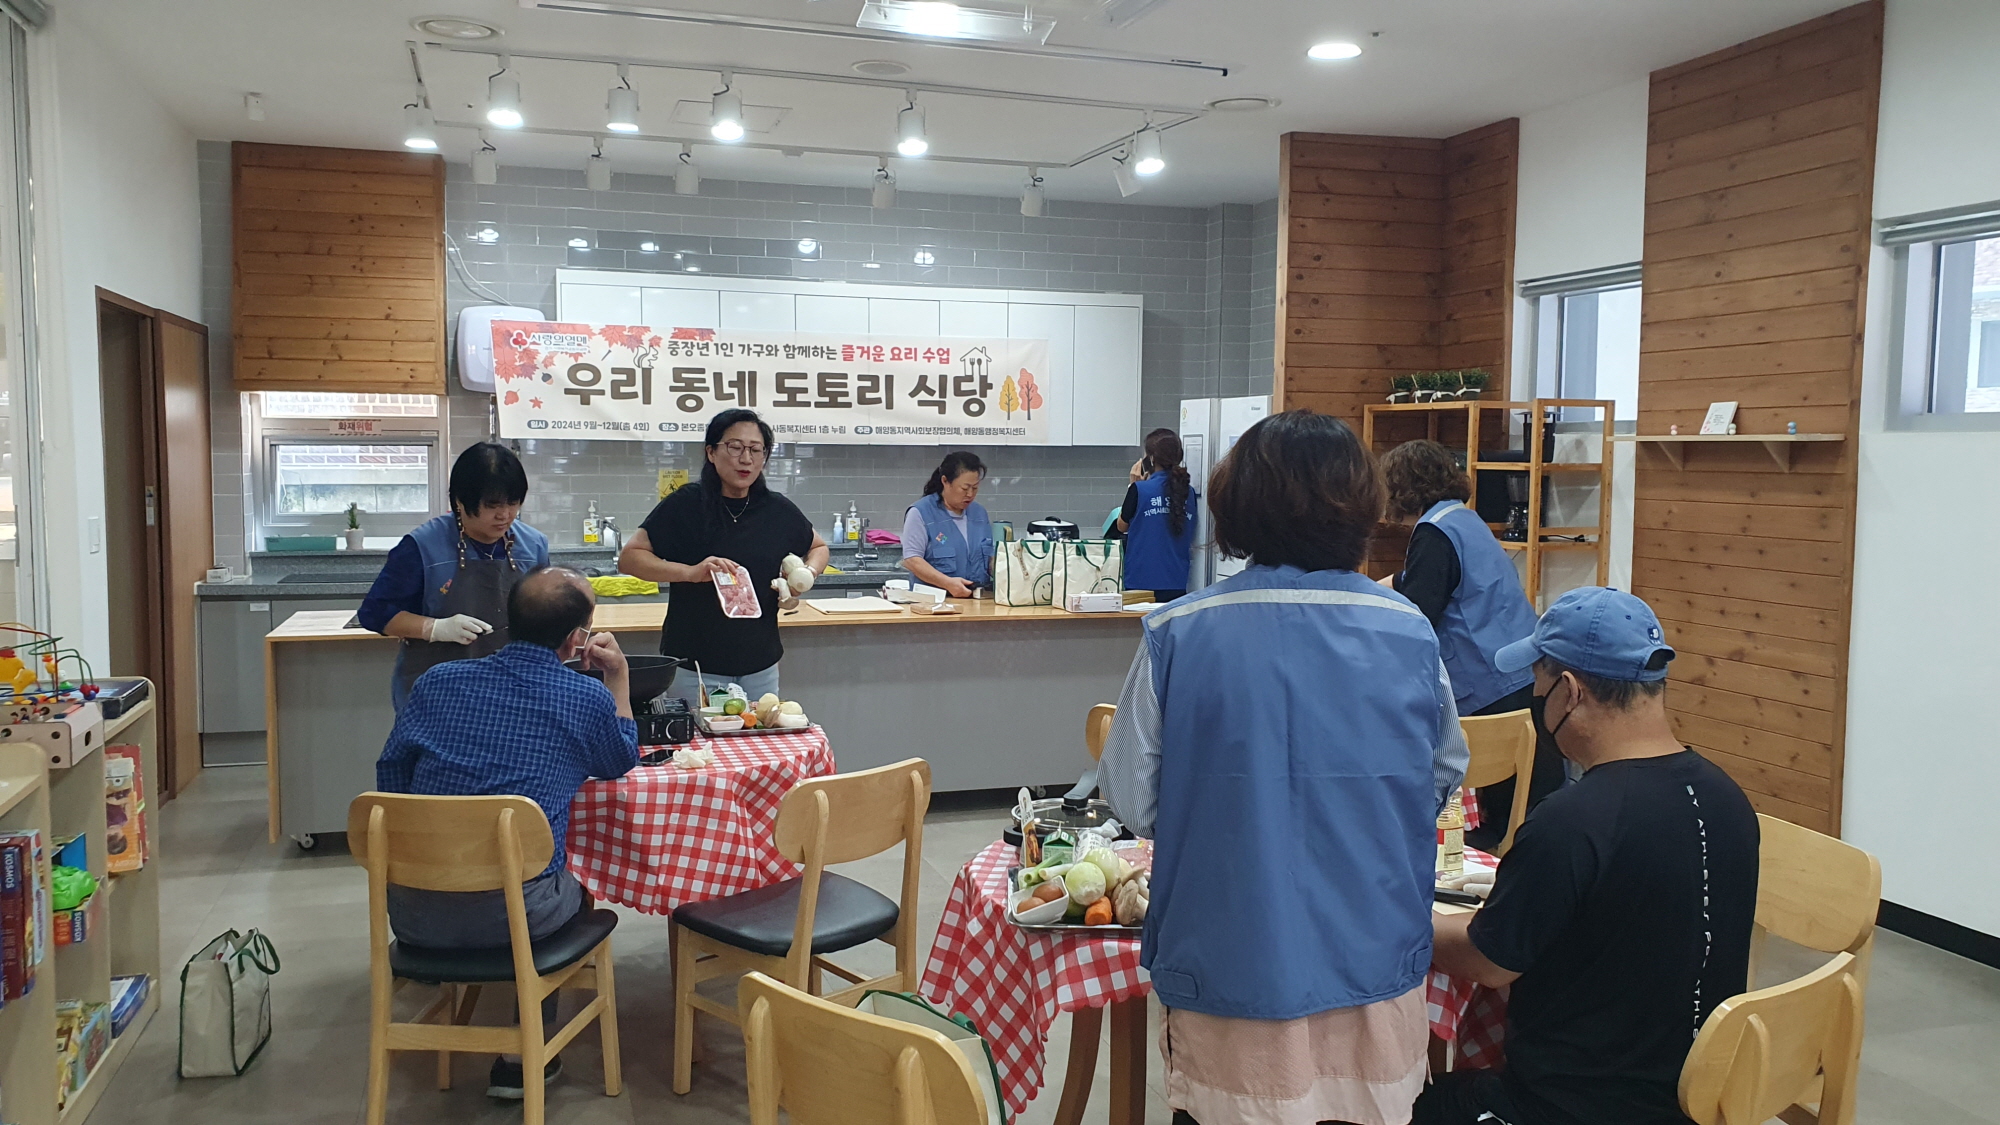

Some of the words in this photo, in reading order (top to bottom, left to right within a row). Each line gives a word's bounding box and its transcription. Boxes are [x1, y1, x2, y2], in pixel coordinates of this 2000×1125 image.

[530, 334, 587, 346] 사랑의열매
[667, 340, 710, 357] 중장년
[713, 342, 734, 357] 1인
[738, 343, 780, 358] 가구와
[782, 343, 838, 360] 함께하는
[841, 344, 885, 362] 즐거운
[889, 346, 918, 362] 요리
[922, 347, 951, 365] 수업
[564, 362, 652, 406] 우리
[669, 366, 758, 413] 동네
[772, 371, 895, 411] 도토리
[908, 373, 994, 418] 식당
[338, 421, 373, 431] 화재위험
[530, 420, 546, 429] 일시
[551, 420, 582, 430] 2024년
[632, 421, 650, 432] 4회)
[661, 423, 677, 431] 장소
[818, 425, 830, 434] 1층
[4, 853, 15, 889] KOSMOS
[74, 911, 82, 942] KOSMOS
